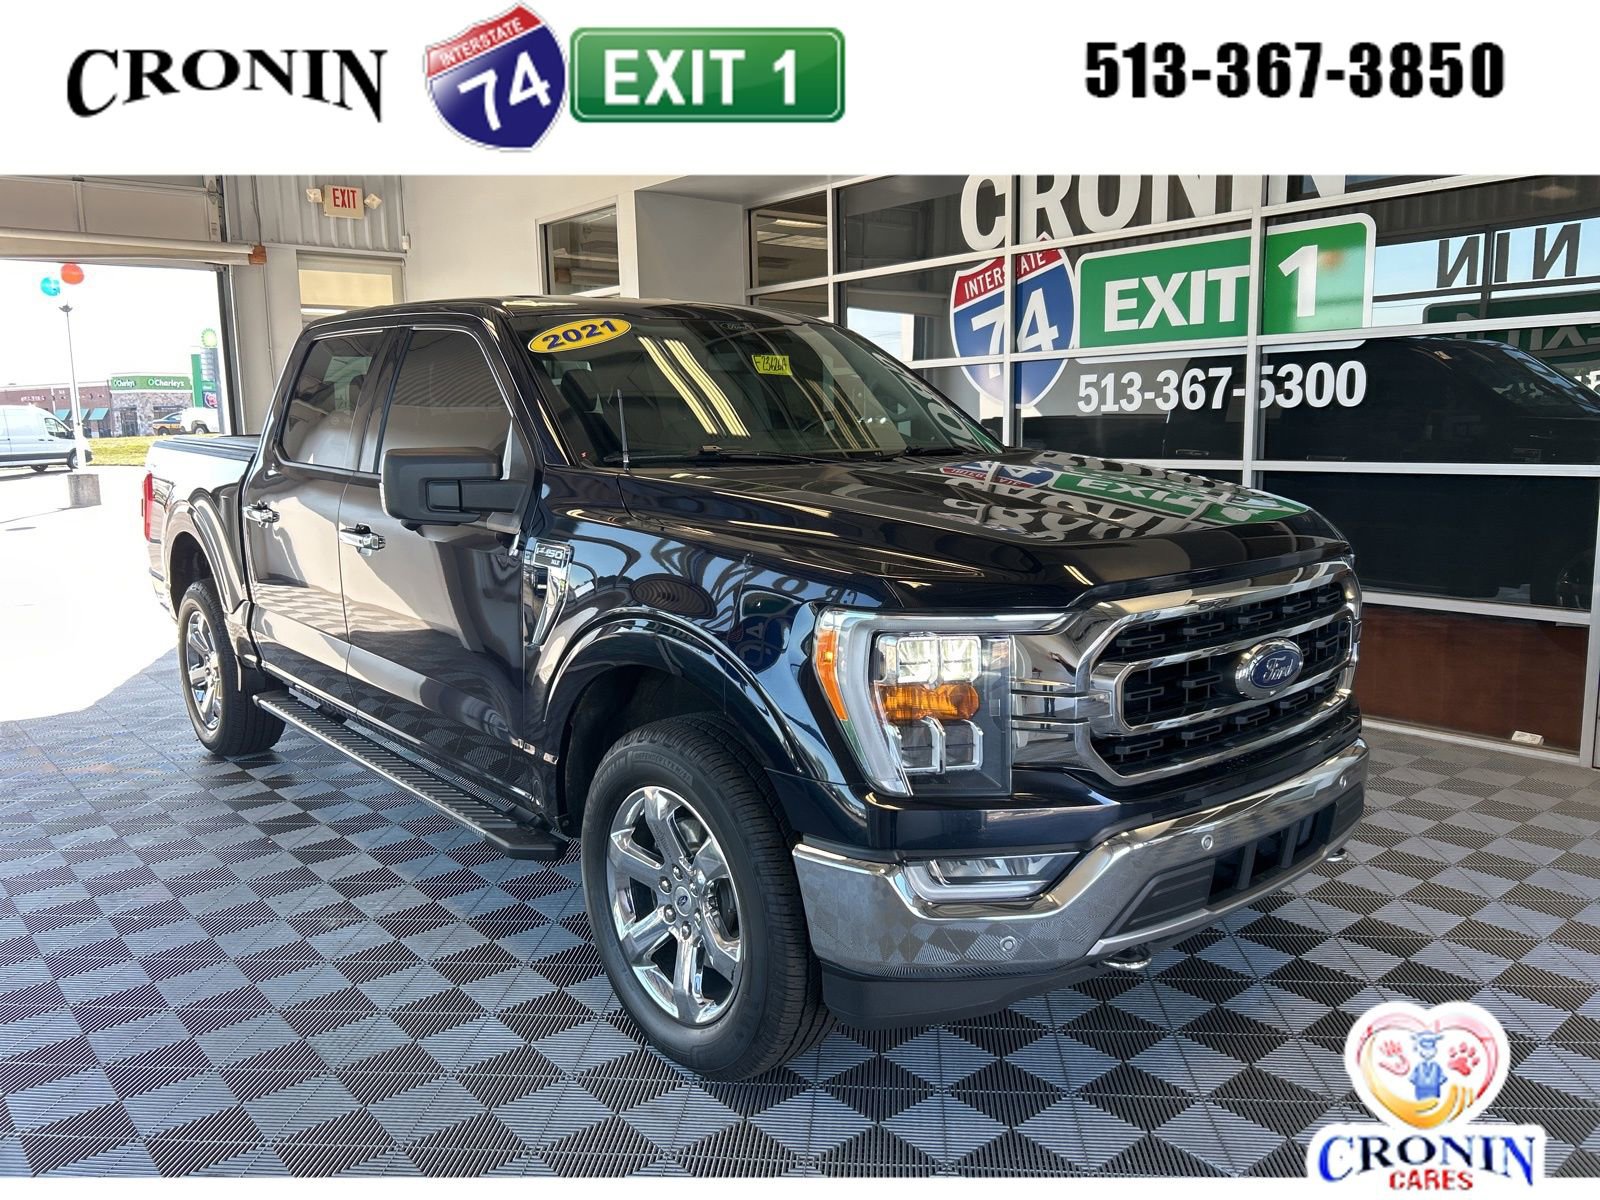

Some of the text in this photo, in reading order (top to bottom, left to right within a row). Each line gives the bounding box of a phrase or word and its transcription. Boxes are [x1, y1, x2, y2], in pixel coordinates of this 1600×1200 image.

[332, 187, 357, 209] EXIT
[1104, 244, 1318, 332] EXIT 1
[542, 320, 618, 350] 2021
[971, 288, 1059, 380] 74
[1077, 360, 1367, 413] 513-367-5300
[1262, 656, 1294, 681] Ford
